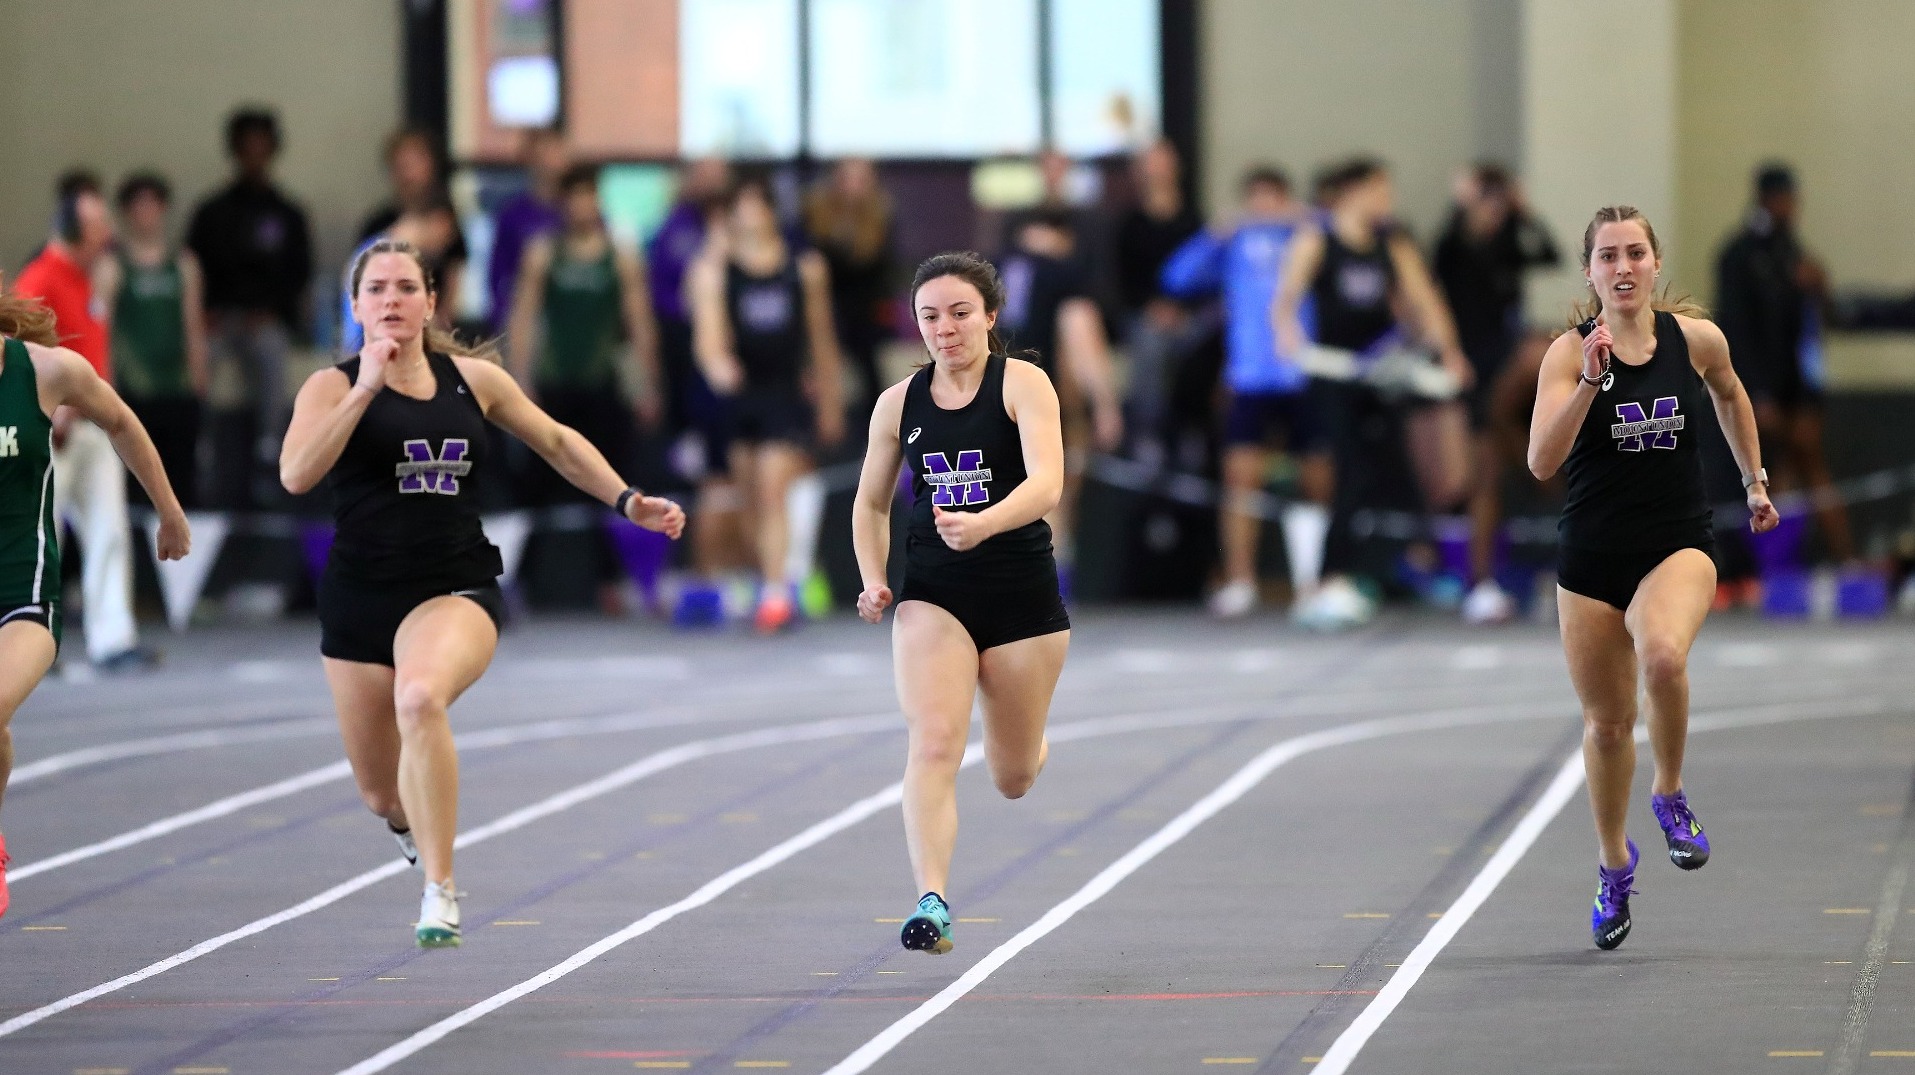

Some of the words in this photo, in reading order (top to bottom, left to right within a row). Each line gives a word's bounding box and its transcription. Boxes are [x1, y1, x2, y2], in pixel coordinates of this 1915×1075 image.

[1613, 421, 1651, 437] MOUNT
[1651, 418, 1683, 432] UNION
[1616, 396, 1679, 452] M
[399, 438, 468, 495] M
[923, 450, 989, 507] M
[924, 473, 957, 484] UNT
[957, 470, 990, 482] UNION
